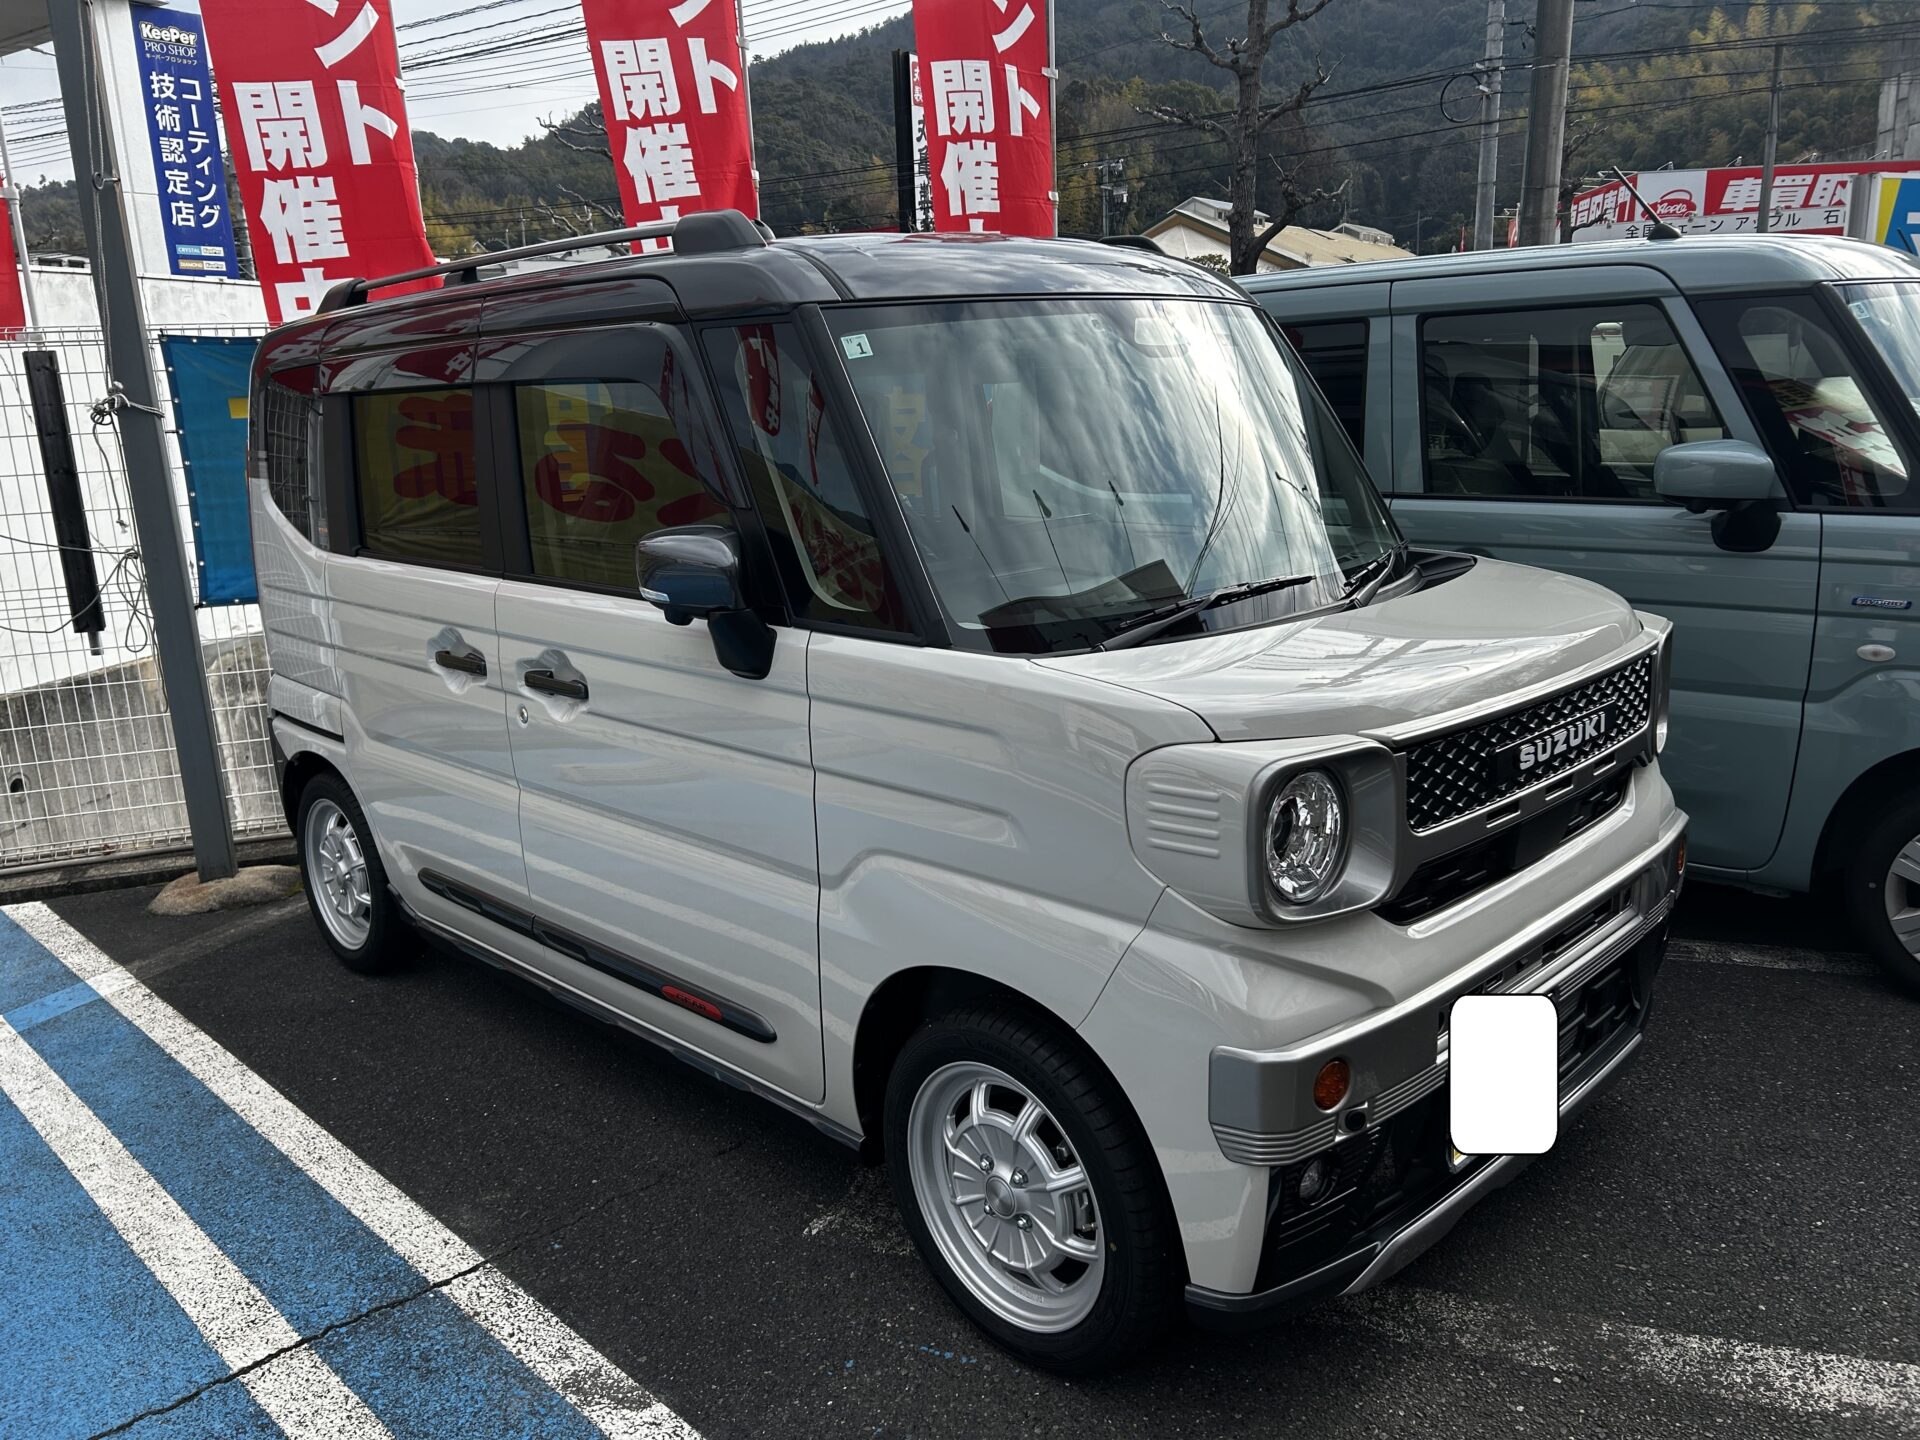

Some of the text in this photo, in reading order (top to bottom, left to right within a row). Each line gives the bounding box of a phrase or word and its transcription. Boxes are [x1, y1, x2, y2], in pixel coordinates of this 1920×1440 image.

[140, 22, 197, 46] KeePer
[144, 41, 197, 57] PRO SHOP
[149, 71, 196, 228] 技術認定店
[180, 77, 221, 229] コーティング
[930, 60, 1001, 232] 開催
[1518, 710, 1607, 771] SUZUKI
